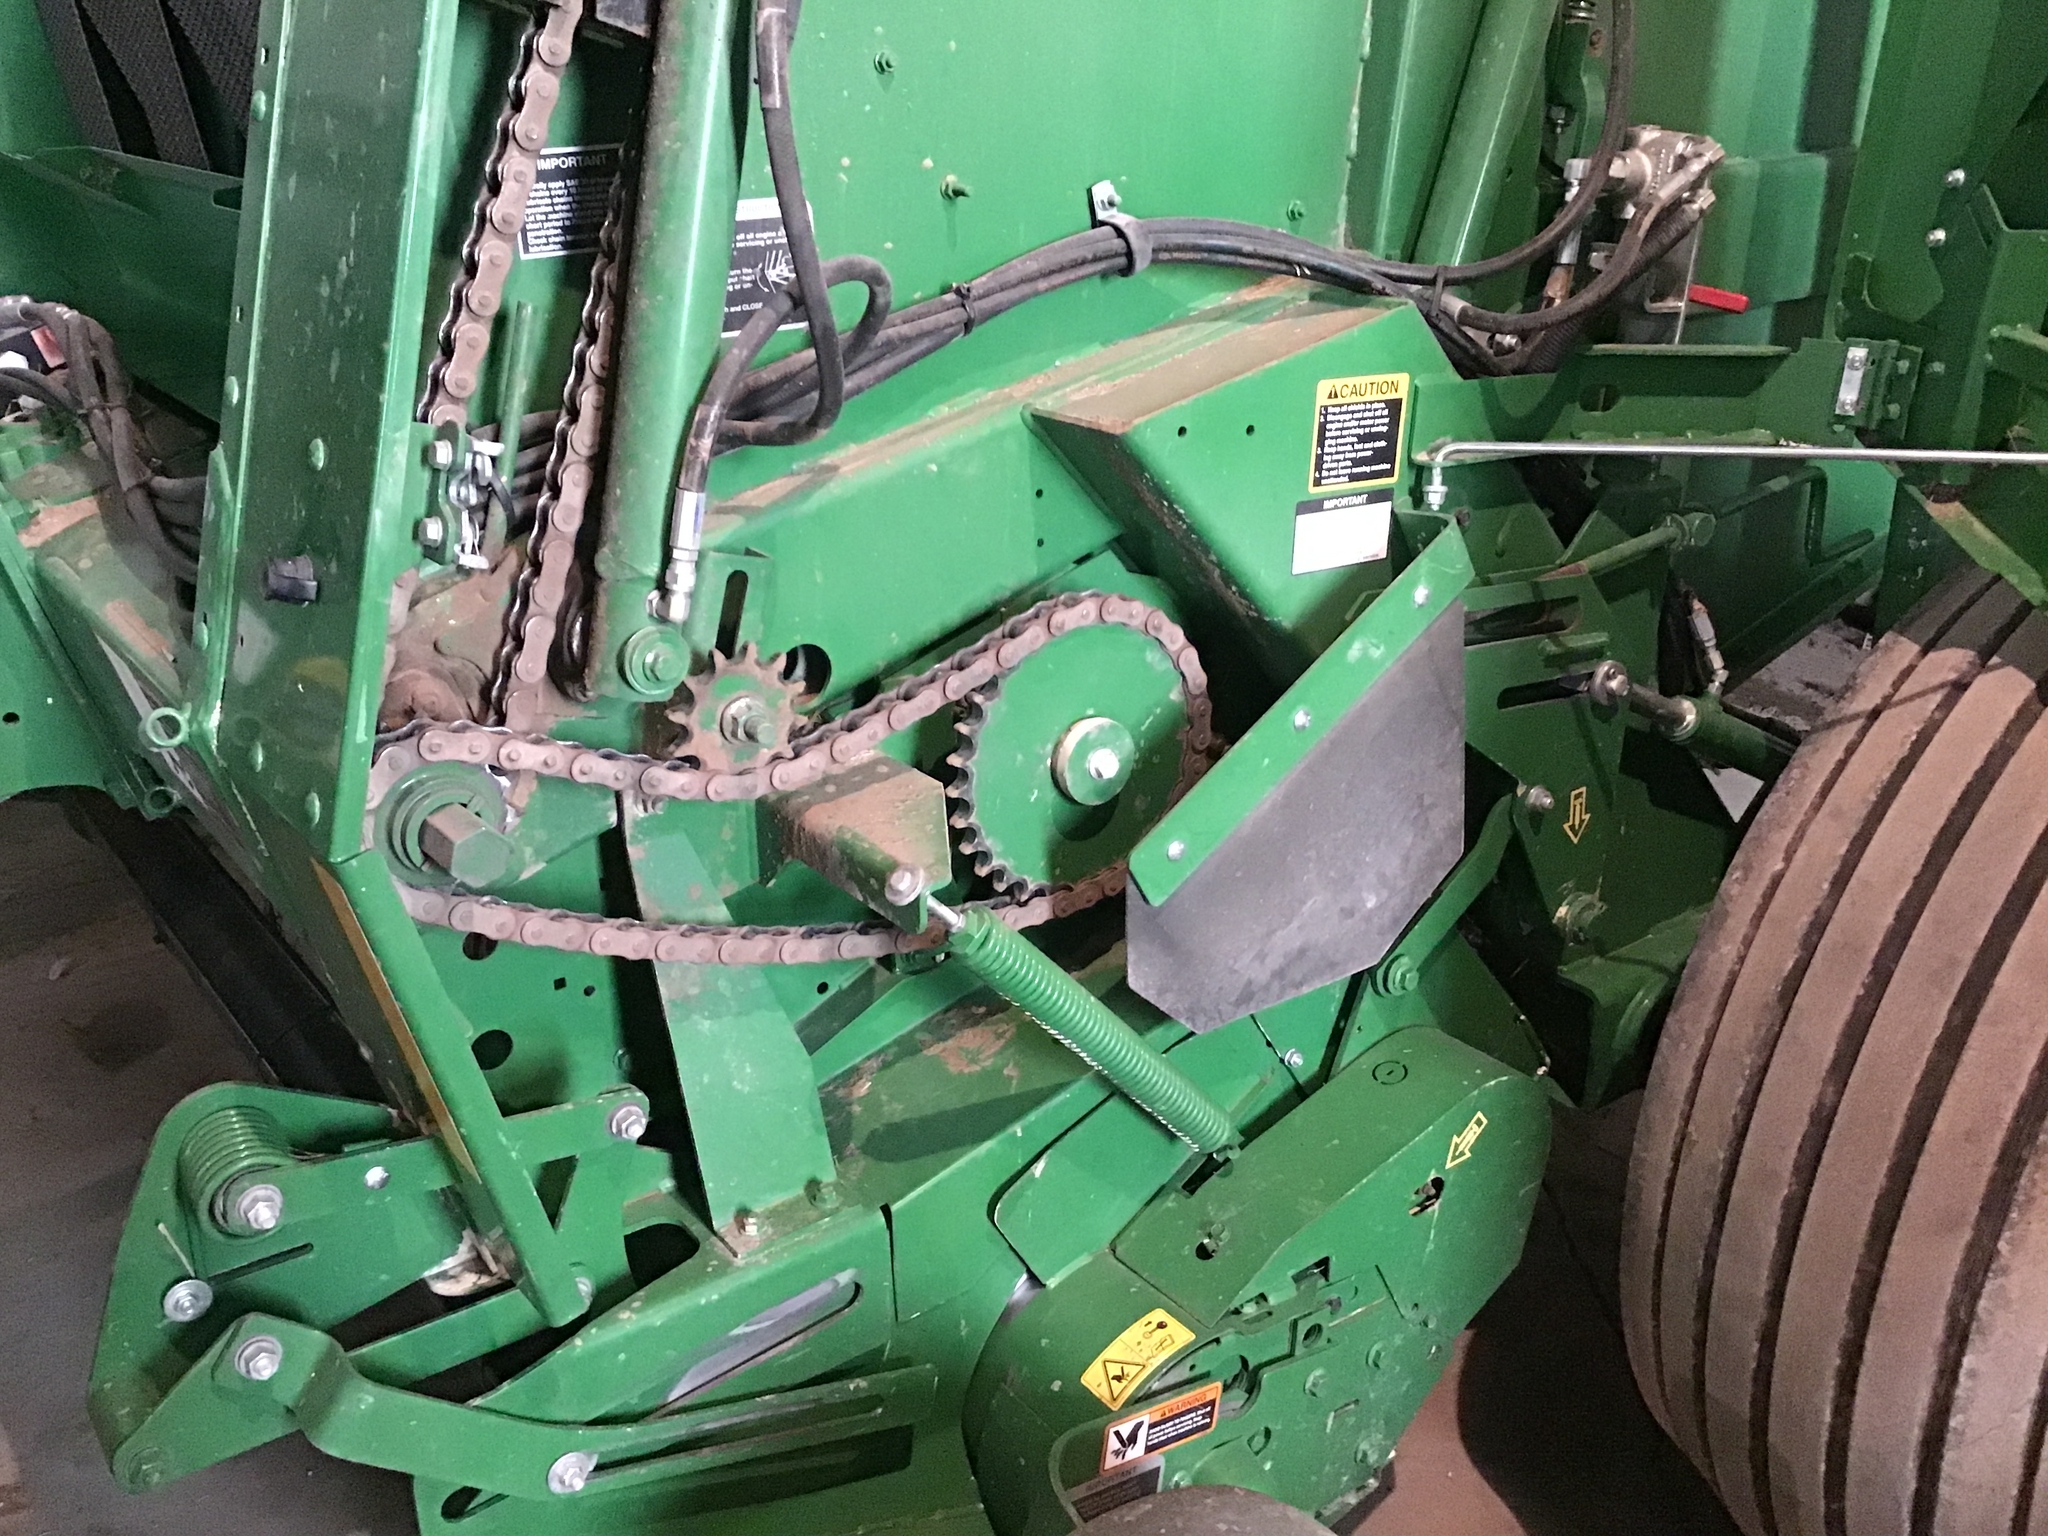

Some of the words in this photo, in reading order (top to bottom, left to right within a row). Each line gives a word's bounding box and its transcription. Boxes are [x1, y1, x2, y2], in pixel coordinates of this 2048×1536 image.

[537, 154, 607, 170] IMPORTANT
[1340, 380, 1399, 398] CAUTION
[1323, 494, 1368, 509] IMPORTANT
[1167, 1393, 1207, 1414] WARNING
